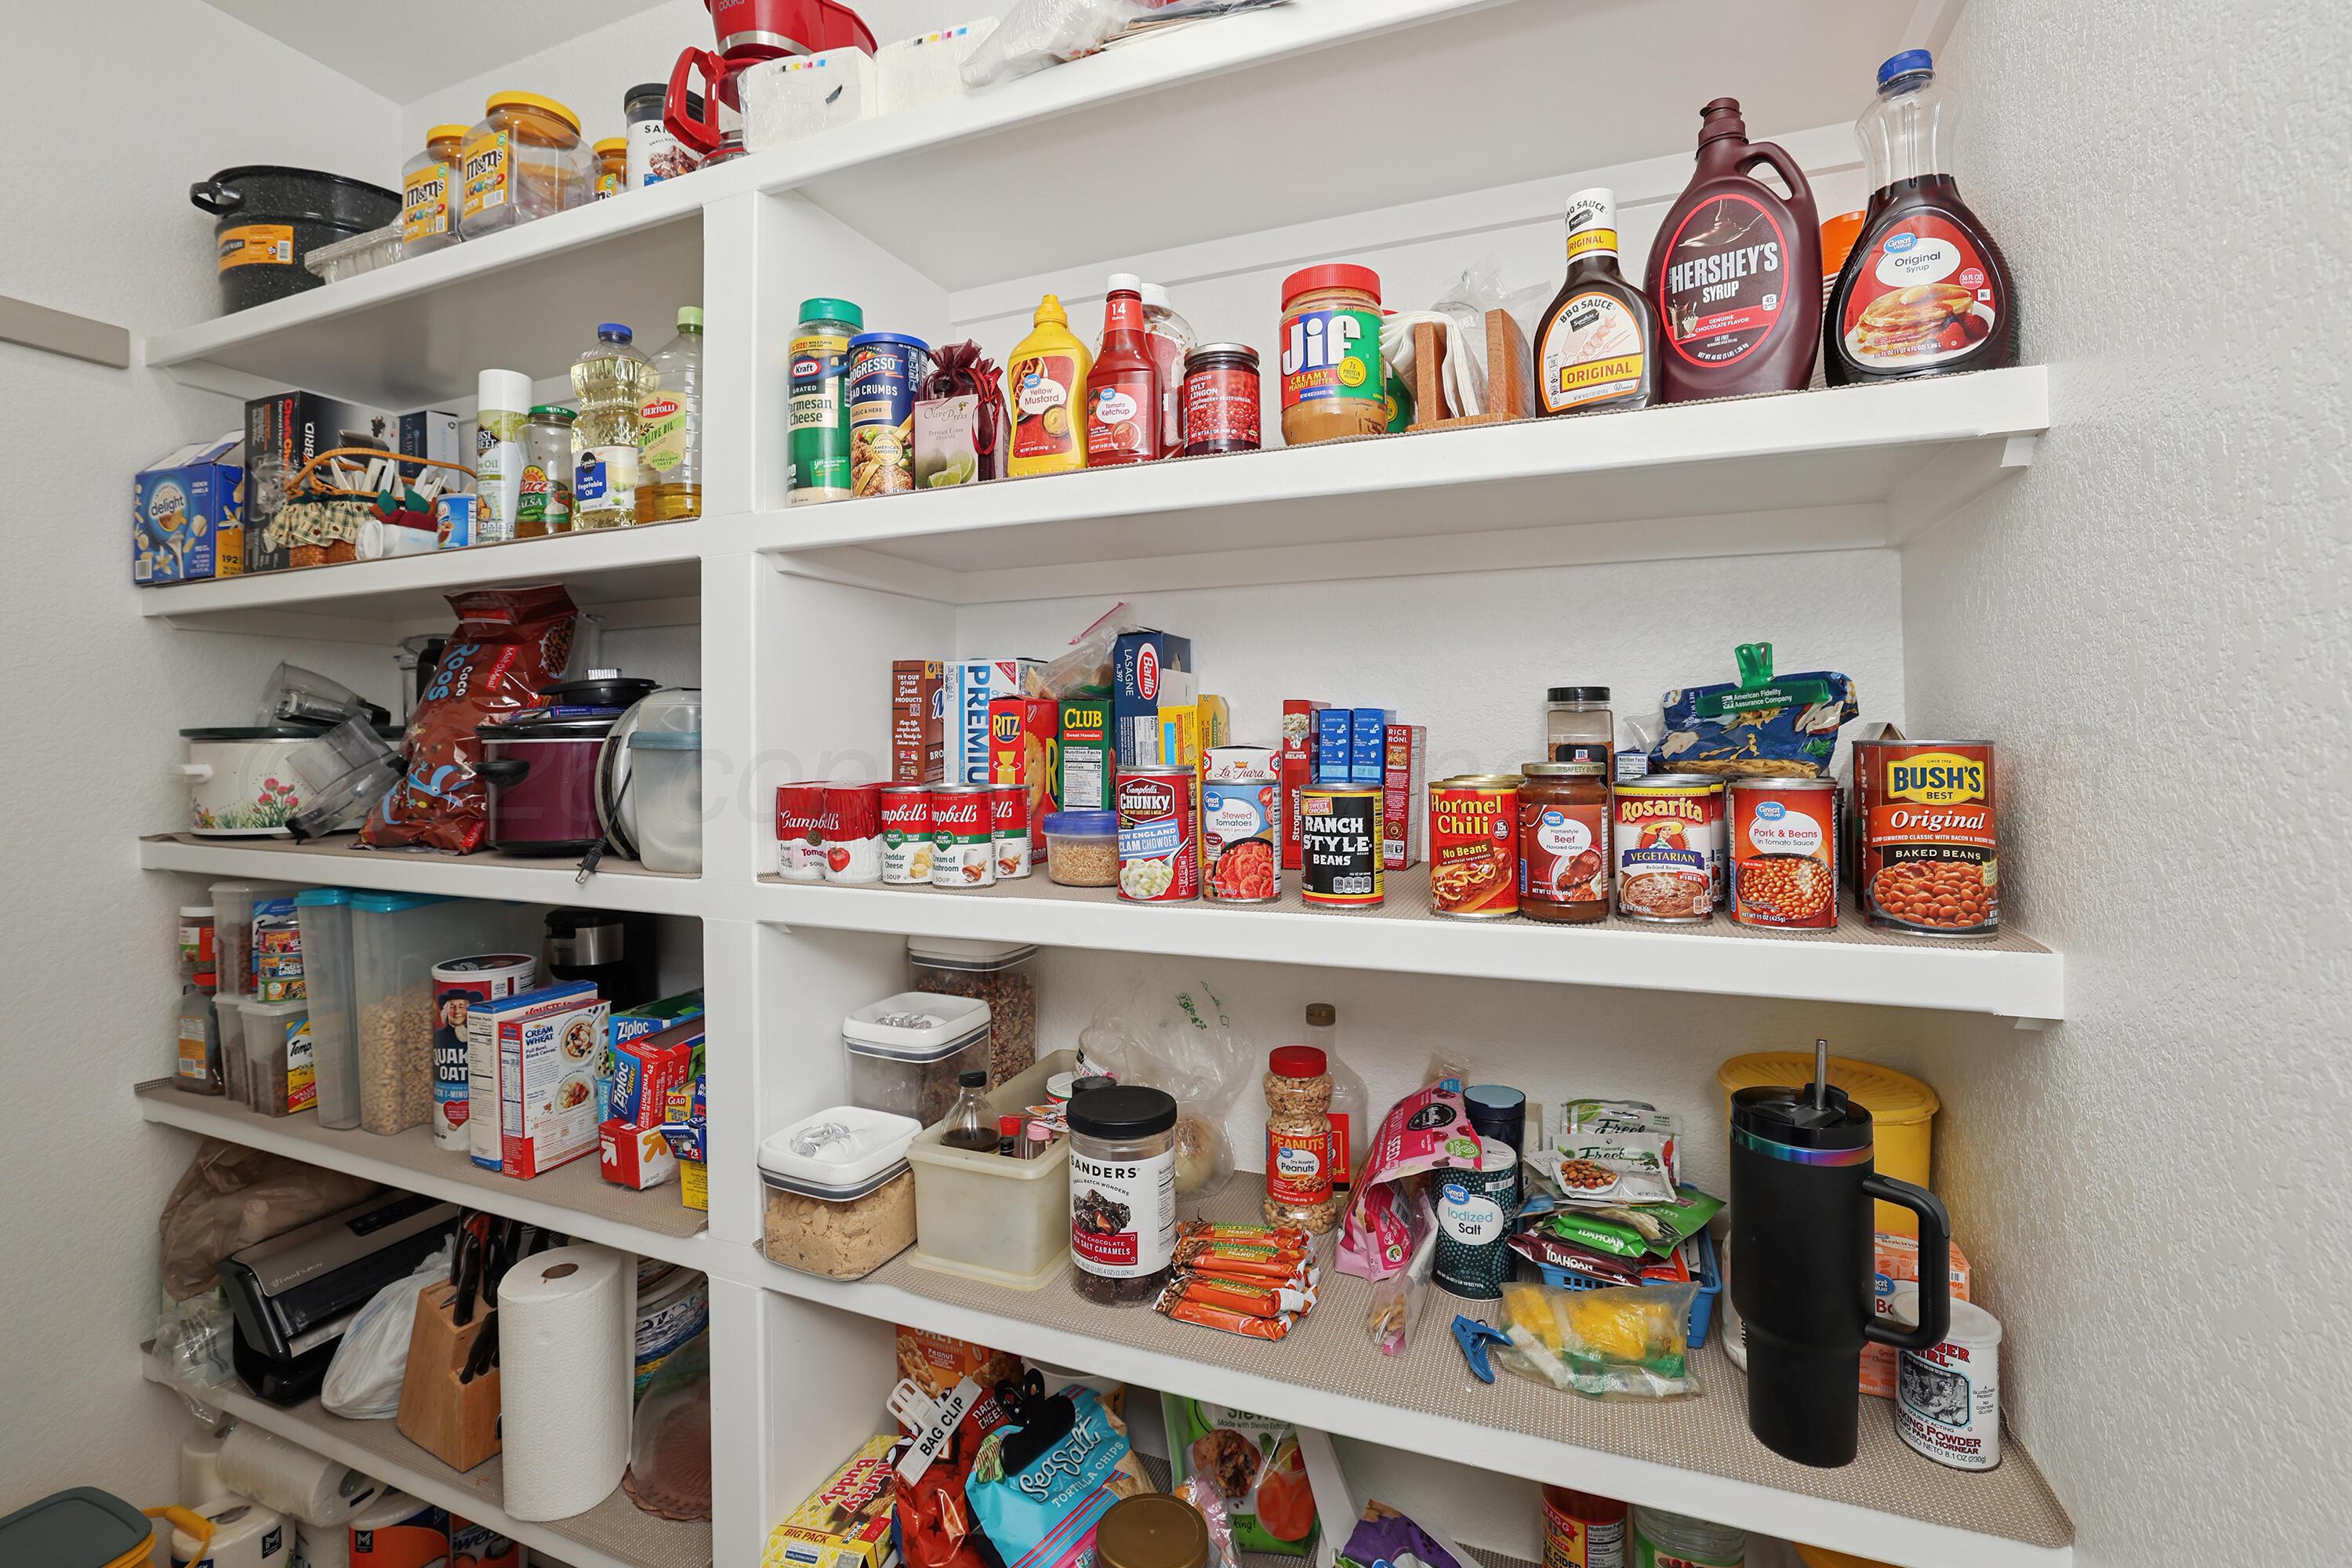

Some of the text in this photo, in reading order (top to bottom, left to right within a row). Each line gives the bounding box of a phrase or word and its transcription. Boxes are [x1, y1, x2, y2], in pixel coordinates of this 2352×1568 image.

[1888, 237, 1911, 246] Great
[1894, 252, 1940, 267] Original
[1671, 242, 1778, 294] HERSHEY'S
[1906, 263, 1929, 274] Syrup
[1702, 281, 1739, 303] SYRUP
[1112, 303, 1126, 314] 14
[1559, 299, 1613, 324] BBQ SAUCE
[1695, 318, 1749, 333] CHOCOLATE FLAVOR
[1709, 315, 1734, 324] GENUINE
[1282, 314, 1361, 376] Jif
[795, 365, 814, 374] Kraft
[1566, 361, 1633, 384] ORIGINAL
[1288, 377, 1334, 391] PEANUT BUTTER
[1290, 371, 1328, 385] CREAMY
[862, 385, 898, 396] CRUMBS
[1190, 383, 1205, 392] SYLT
[1190, 387, 1218, 400] LINGON
[1024, 395, 1059, 405] Mustard
[546, 406, 568, 415] MILD
[642, 403, 677, 417] BERTOLLI
[1102, 408, 1131, 417] Ketchup
[789, 412, 823, 426] Cheese
[576, 480, 603, 492] Vegetable
[584, 488, 593, 496] Oil
[151, 495, 186, 517] delight
[221, 554, 238, 564] 192
[1124, 649, 1134, 696] LASAGNE
[1142, 655, 1153, 695] Barilla
[899, 686, 918, 695] Great
[1733, 688, 1781, 701] American Fidelity
[1734, 695, 1792, 709] Assurance Company
[993, 714, 1021, 737] RITZ
[1064, 708, 1103, 729] CLUB
[1214, 766, 1265, 779] La Tiara
[1893, 766, 1981, 793] BUSH'S
[1127, 784, 1159, 795] Campbell's
[1926, 791, 1954, 800] BEST
[1120, 795, 1170, 811] CHUNKY
[1431, 795, 1502, 814] Hormel
[1621, 797, 1704, 823] Rosarita
[1759, 806, 1781, 815] Great
[780, 810, 840, 832] Campbell's
[1305, 816, 1363, 833] RANCH
[1437, 815, 1489, 835] Chili
[1891, 810, 1984, 831] Original
[1132, 828, 1176, 840] ENGLAND
[1554, 834, 1576, 844] Beef
[1754, 829, 1817, 838] Pork & Beans
[1872, 834, 1908, 843] SLOW-SIMMERED
[1119, 836, 1178, 853] CLAM CHOWDER
[1302, 835, 1370, 852] STYLE
[884, 852, 906, 862] Cheddar
[1443, 844, 1487, 858] No Beans
[1631, 853, 1696, 863] VEGETARIAN
[1896, 849, 1981, 860] BAKED BEANS
[1313, 855, 1351, 866] BEANS
[524, 1025, 554, 1040] CREAM
[617, 1020, 650, 1040] Ziploc
[525, 1033, 554, 1046] WHEAT
[613, 1061, 630, 1109] Ziploc
[627, 1066, 636, 1095] Slider
[641, 1073, 649, 1112] ALMACENAR
[667, 1096, 686, 1106] GLAD
[600, 1133, 616, 1142] storage
[1272, 1134, 1325, 1151] PEANUTS
[690, 1148, 699, 1156] 75
[1385, 1134, 1403, 1163] SEED
[1070, 1154, 1137, 1178] SANDERS
[1281, 1163, 1315, 1173] Peanuts
[1101, 1182, 1130, 1196] WONDERS
[1445, 1187, 1465, 1198] Great
[1450, 1192, 1465, 1203] Value
[1447, 1207, 1494, 1223] Iodized
[1458, 1222, 1481, 1236] Salt
[1087, 1236, 1125, 1247] CHOCOLATE
[1577, 1229, 1625, 1250] IDAHOAN
[1080, 1240, 1131, 1255] SALT CARAMELS
[1545, 1248, 1593, 1272] IDAHOAN
[927, 1347, 953, 1360] Peanut
[920, 1396, 965, 1457] BAG CLIP
[1907, 1408, 1955, 1432] DOUBLE ACTING
[1911, 1429, 1980, 1455] PARA HORNEAR
[1926, 1426, 1982, 1447] POWDER
[1922, 1441, 1987, 1464] NETO 8.1 OZ (230g)
[1051, 1441, 1124, 1508] TORTILLA CHIPS
[818, 1457, 879, 1508] Buddy
[839, 1462, 893, 1514] Nutty
[783, 1527, 830, 1544] BIG PACK
